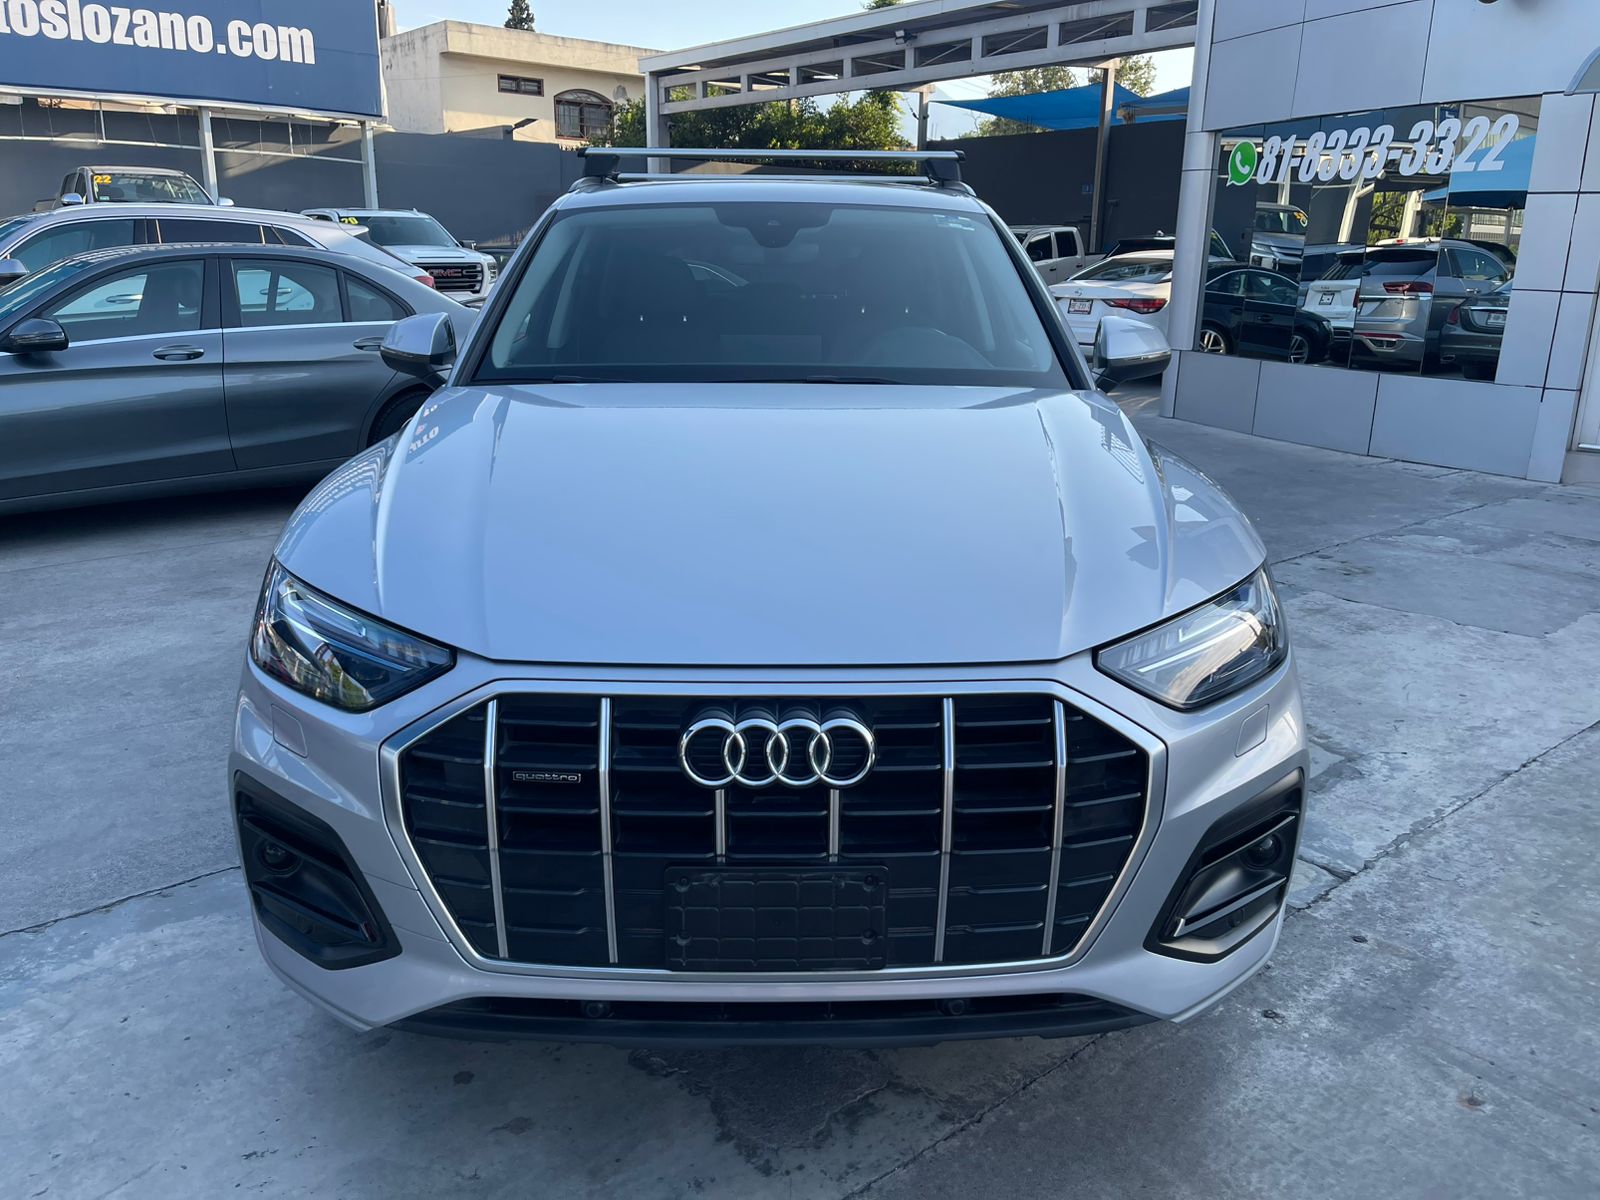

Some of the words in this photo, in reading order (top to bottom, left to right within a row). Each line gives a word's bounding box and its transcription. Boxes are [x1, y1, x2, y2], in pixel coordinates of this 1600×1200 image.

[1256, 113, 1519, 185] 81-8333-3322
[93, 174, 112, 184] 22
[427, 268, 462, 277] GMC
